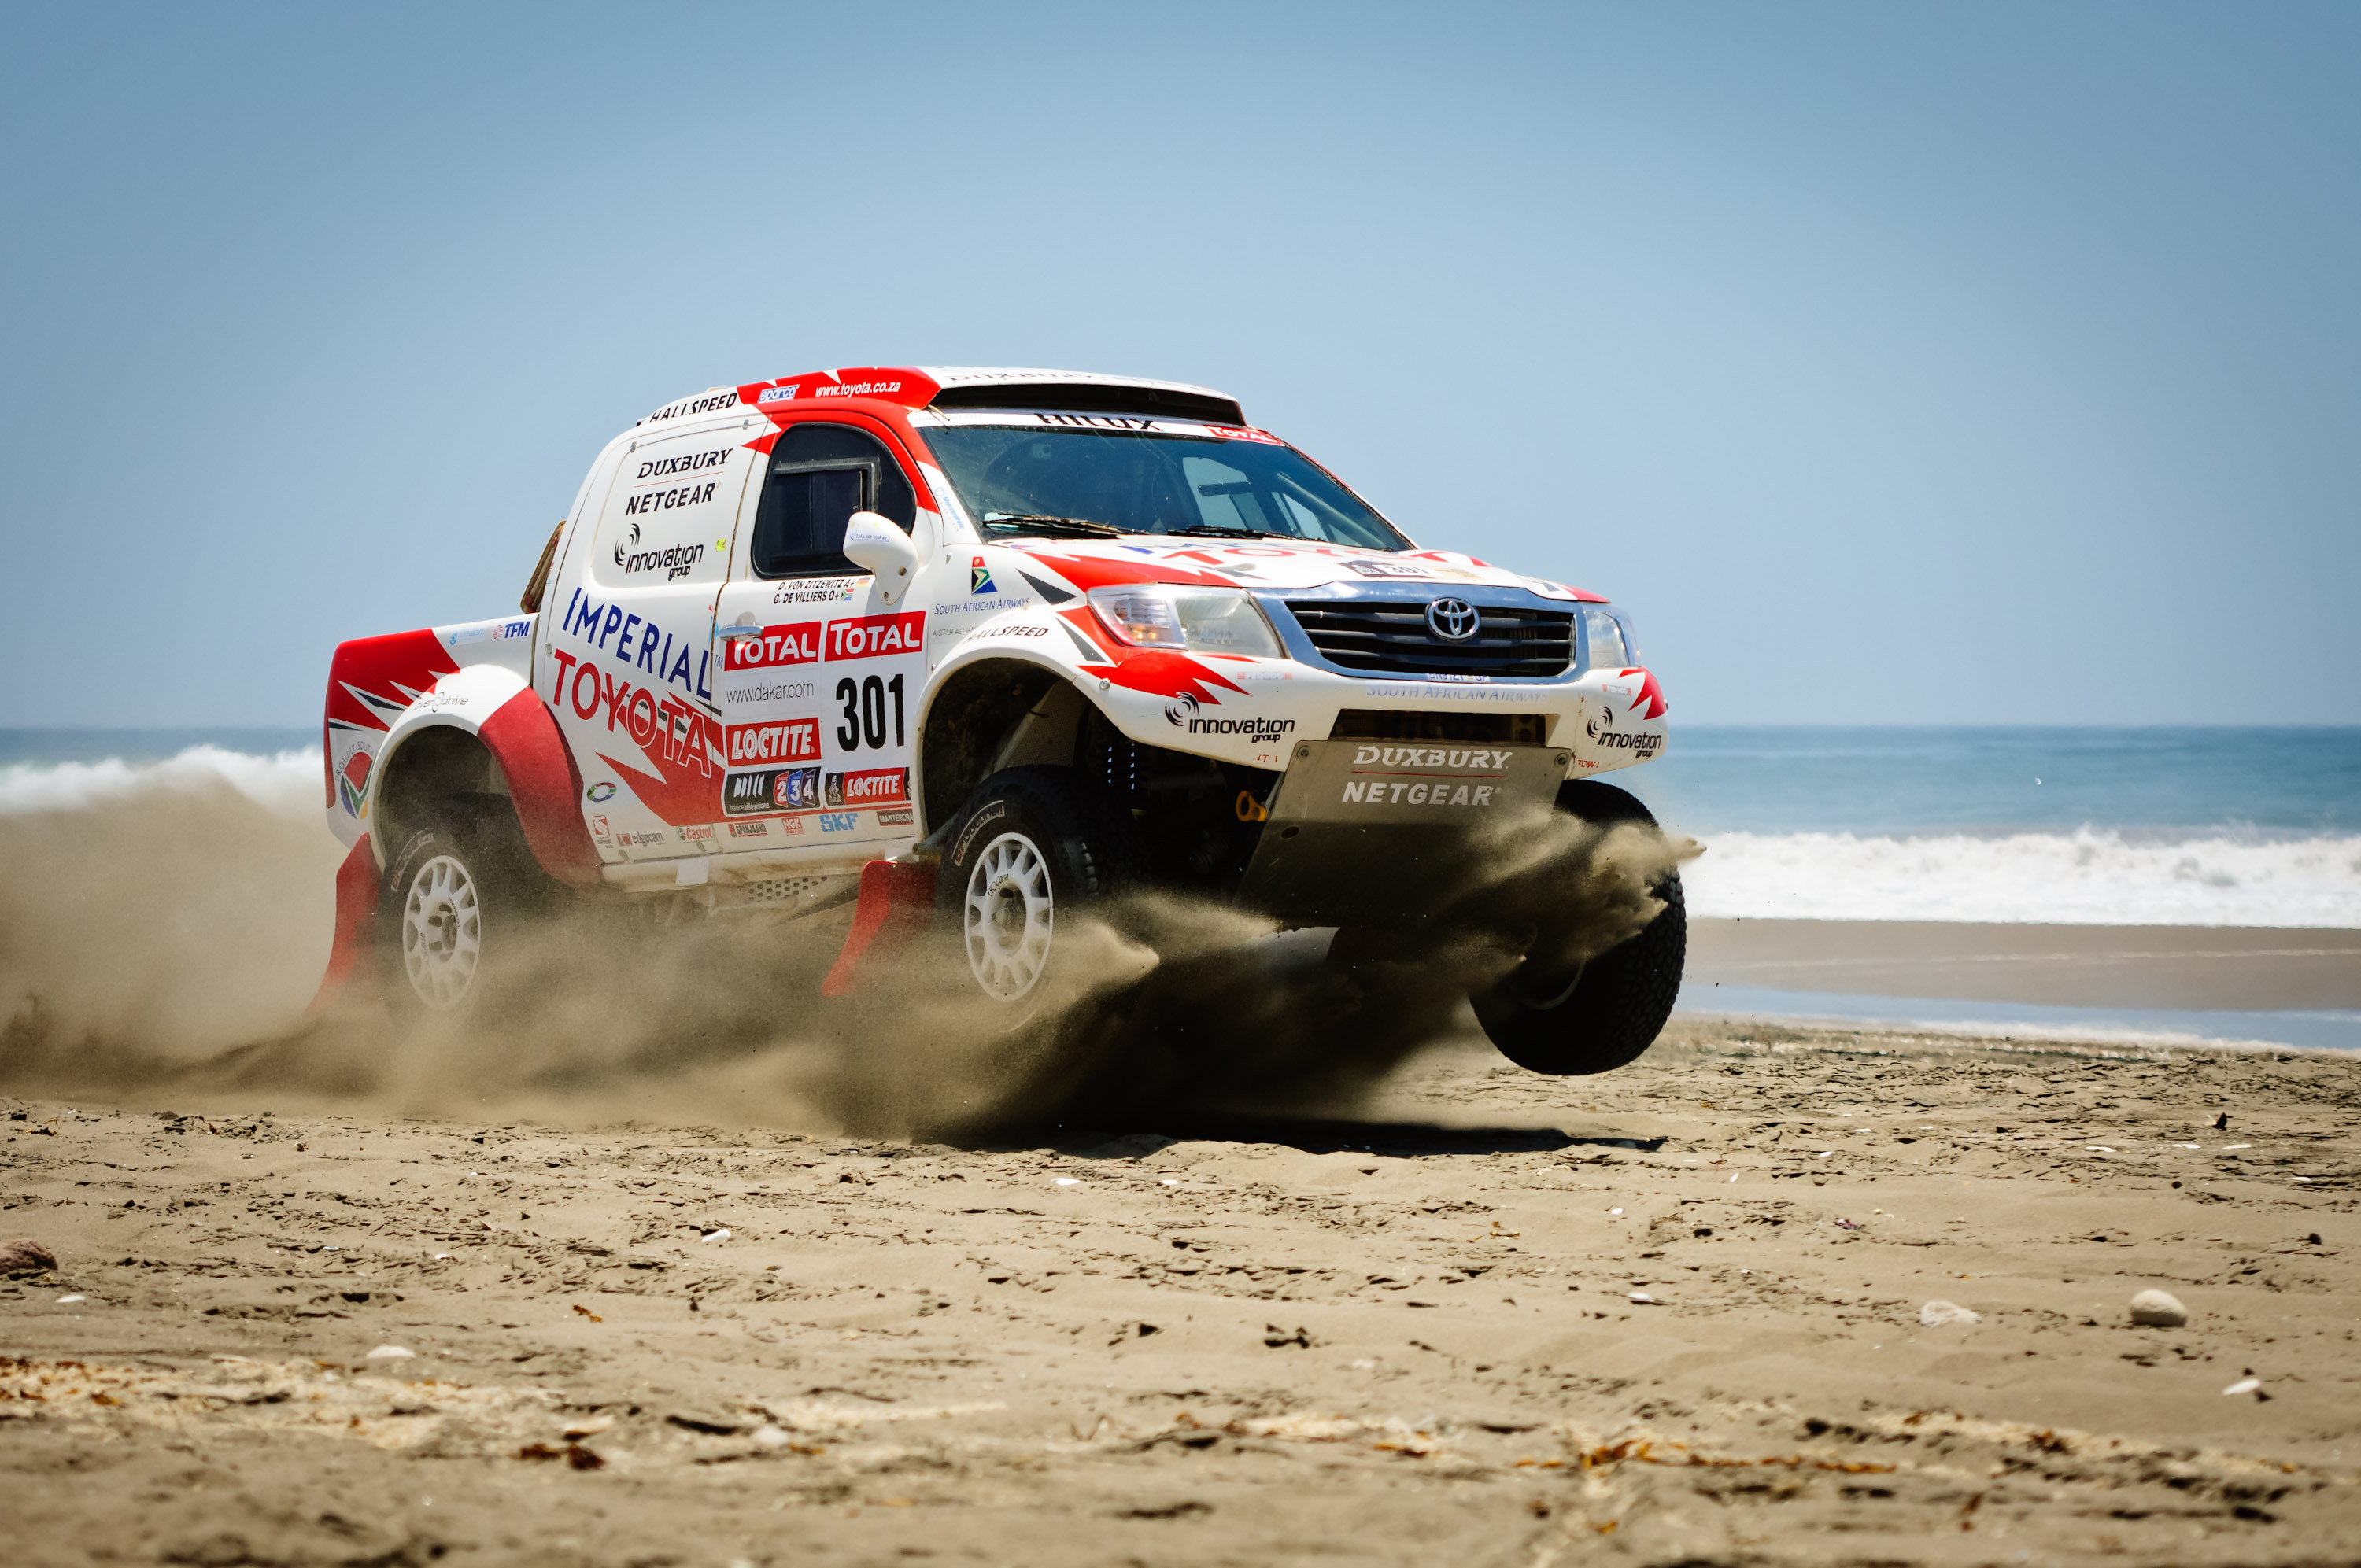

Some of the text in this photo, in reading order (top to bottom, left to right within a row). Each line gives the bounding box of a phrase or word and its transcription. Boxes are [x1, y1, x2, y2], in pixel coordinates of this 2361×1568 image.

[759, 388, 796, 402] sparco
[815, 382, 901, 398] www.toyota.co.za
[649, 393, 737, 422] HALLSPEED
[1034, 413, 1165, 432] HILUX
[1206, 426, 1278, 443] TOTAL
[625, 482, 716, 515] NETGEAR
[626, 544, 704, 574] innovation
[668, 566, 691, 581] group
[788, 581, 804, 590] VON
[804, 579, 845, 589] ZITZEWITZ
[783, 592, 793, 603] DE
[795, 590, 827, 602] VILLIERS
[934, 598, 1030, 614] SOUTH AFRICAN AIRWAYS
[504, 621, 531, 639] TFM
[830, 622, 921, 655] TOTAL
[562, 587, 712, 701] IMPERIAL
[726, 681, 815, 704] www.dakar.com
[1366, 685, 1420, 698] SOUTH
[1423, 685, 1487, 700] AFRICAN
[553, 648, 711, 778] TOYOTA
[836, 673, 905, 752] 301
[1189, 717, 1295, 734] innovation
[731, 724, 814, 760] LOCTITE
[1251, 734, 1280, 743] group
[1598, 732, 1661, 749] innovation
[335, 741, 374, 781] PROUDLY SOUTH
[1635, 750, 1653, 759] group
[776, 778, 814, 802] 2 3 4
[847, 774, 901, 798] LOCTITE
[1342, 781, 1494, 806] NETGEAR
[782, 817, 802, 830] NGK
[819, 813, 859, 832] SKF
[632, 831, 664, 847] edgecam
[686, 827, 713, 840] Castrol
